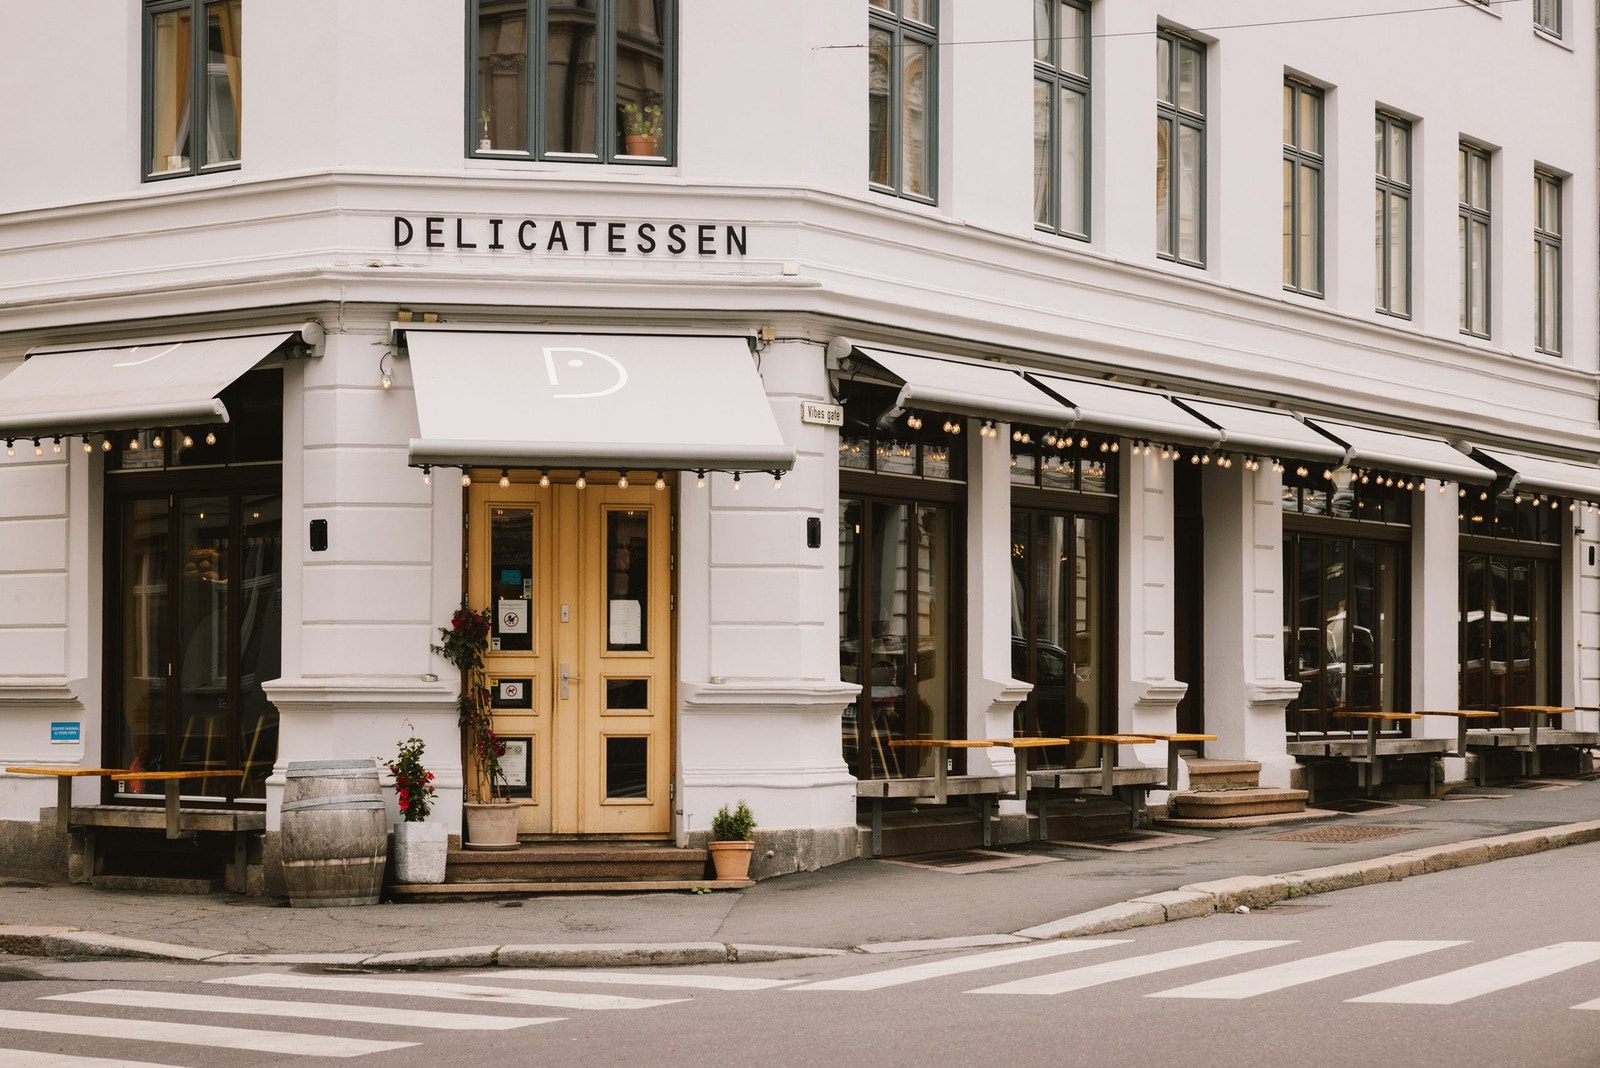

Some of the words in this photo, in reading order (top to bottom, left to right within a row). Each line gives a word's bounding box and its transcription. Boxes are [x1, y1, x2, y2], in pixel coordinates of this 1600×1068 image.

[394, 216, 747, 256] DELICATESSEN
[807, 405, 825, 419] Vibes
[827, 409, 840, 423] gate
